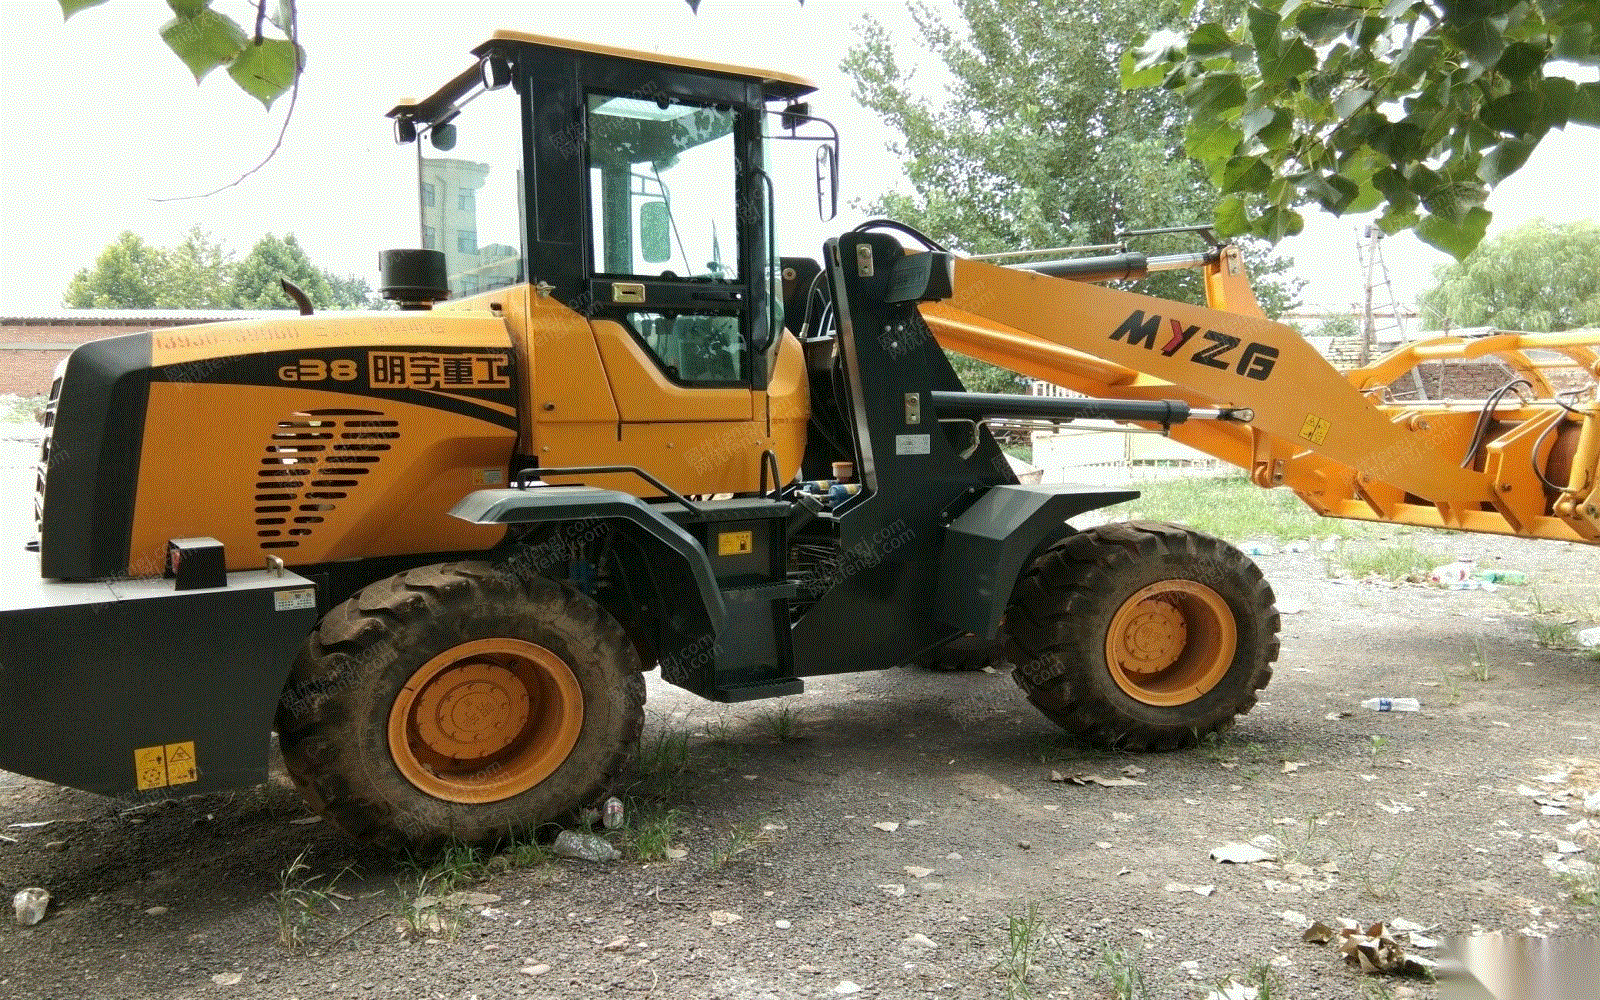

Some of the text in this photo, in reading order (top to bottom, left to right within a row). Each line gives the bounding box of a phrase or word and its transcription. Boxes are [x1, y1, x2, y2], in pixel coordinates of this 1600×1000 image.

[1108, 309, 1279, 381] MYZG
[278, 359, 357, 381] G38
[368, 351, 510, 388] 明宇重工
